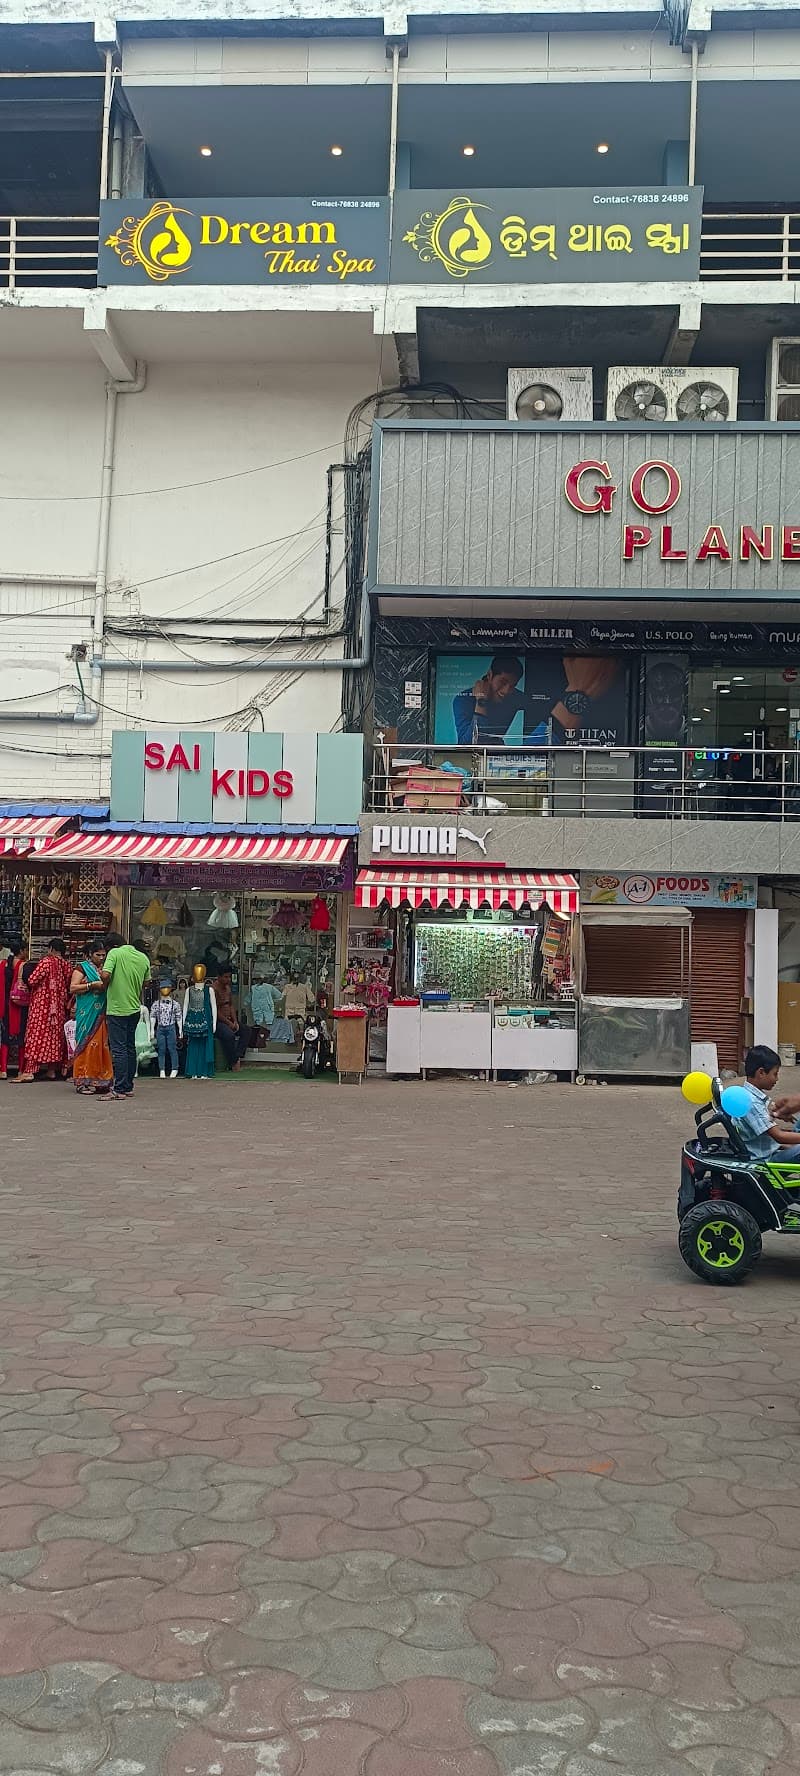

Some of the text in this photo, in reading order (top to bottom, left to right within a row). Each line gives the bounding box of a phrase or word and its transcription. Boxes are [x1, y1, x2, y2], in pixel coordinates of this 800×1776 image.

[593, 194, 689, 204] Contact-76838 24896
[200, 215, 337, 245] Dream
[568, 224, 633, 253] ଥାଇ
[264, 250, 376, 279] Thai Spa
[565, 460, 682, 514] GO
[622, 524, 800, 561] PLANE
[530, 628, 573, 638] KILLER
[645, 631, 694, 641] U.S. POLO
[579, 728, 617, 739] TITAN
[144, 742, 202, 771] SAI
[212, 769, 294, 798] KIDS
[372, 825, 457, 854] PUMA
[627, 877, 710, 897] A-1 FOODS
